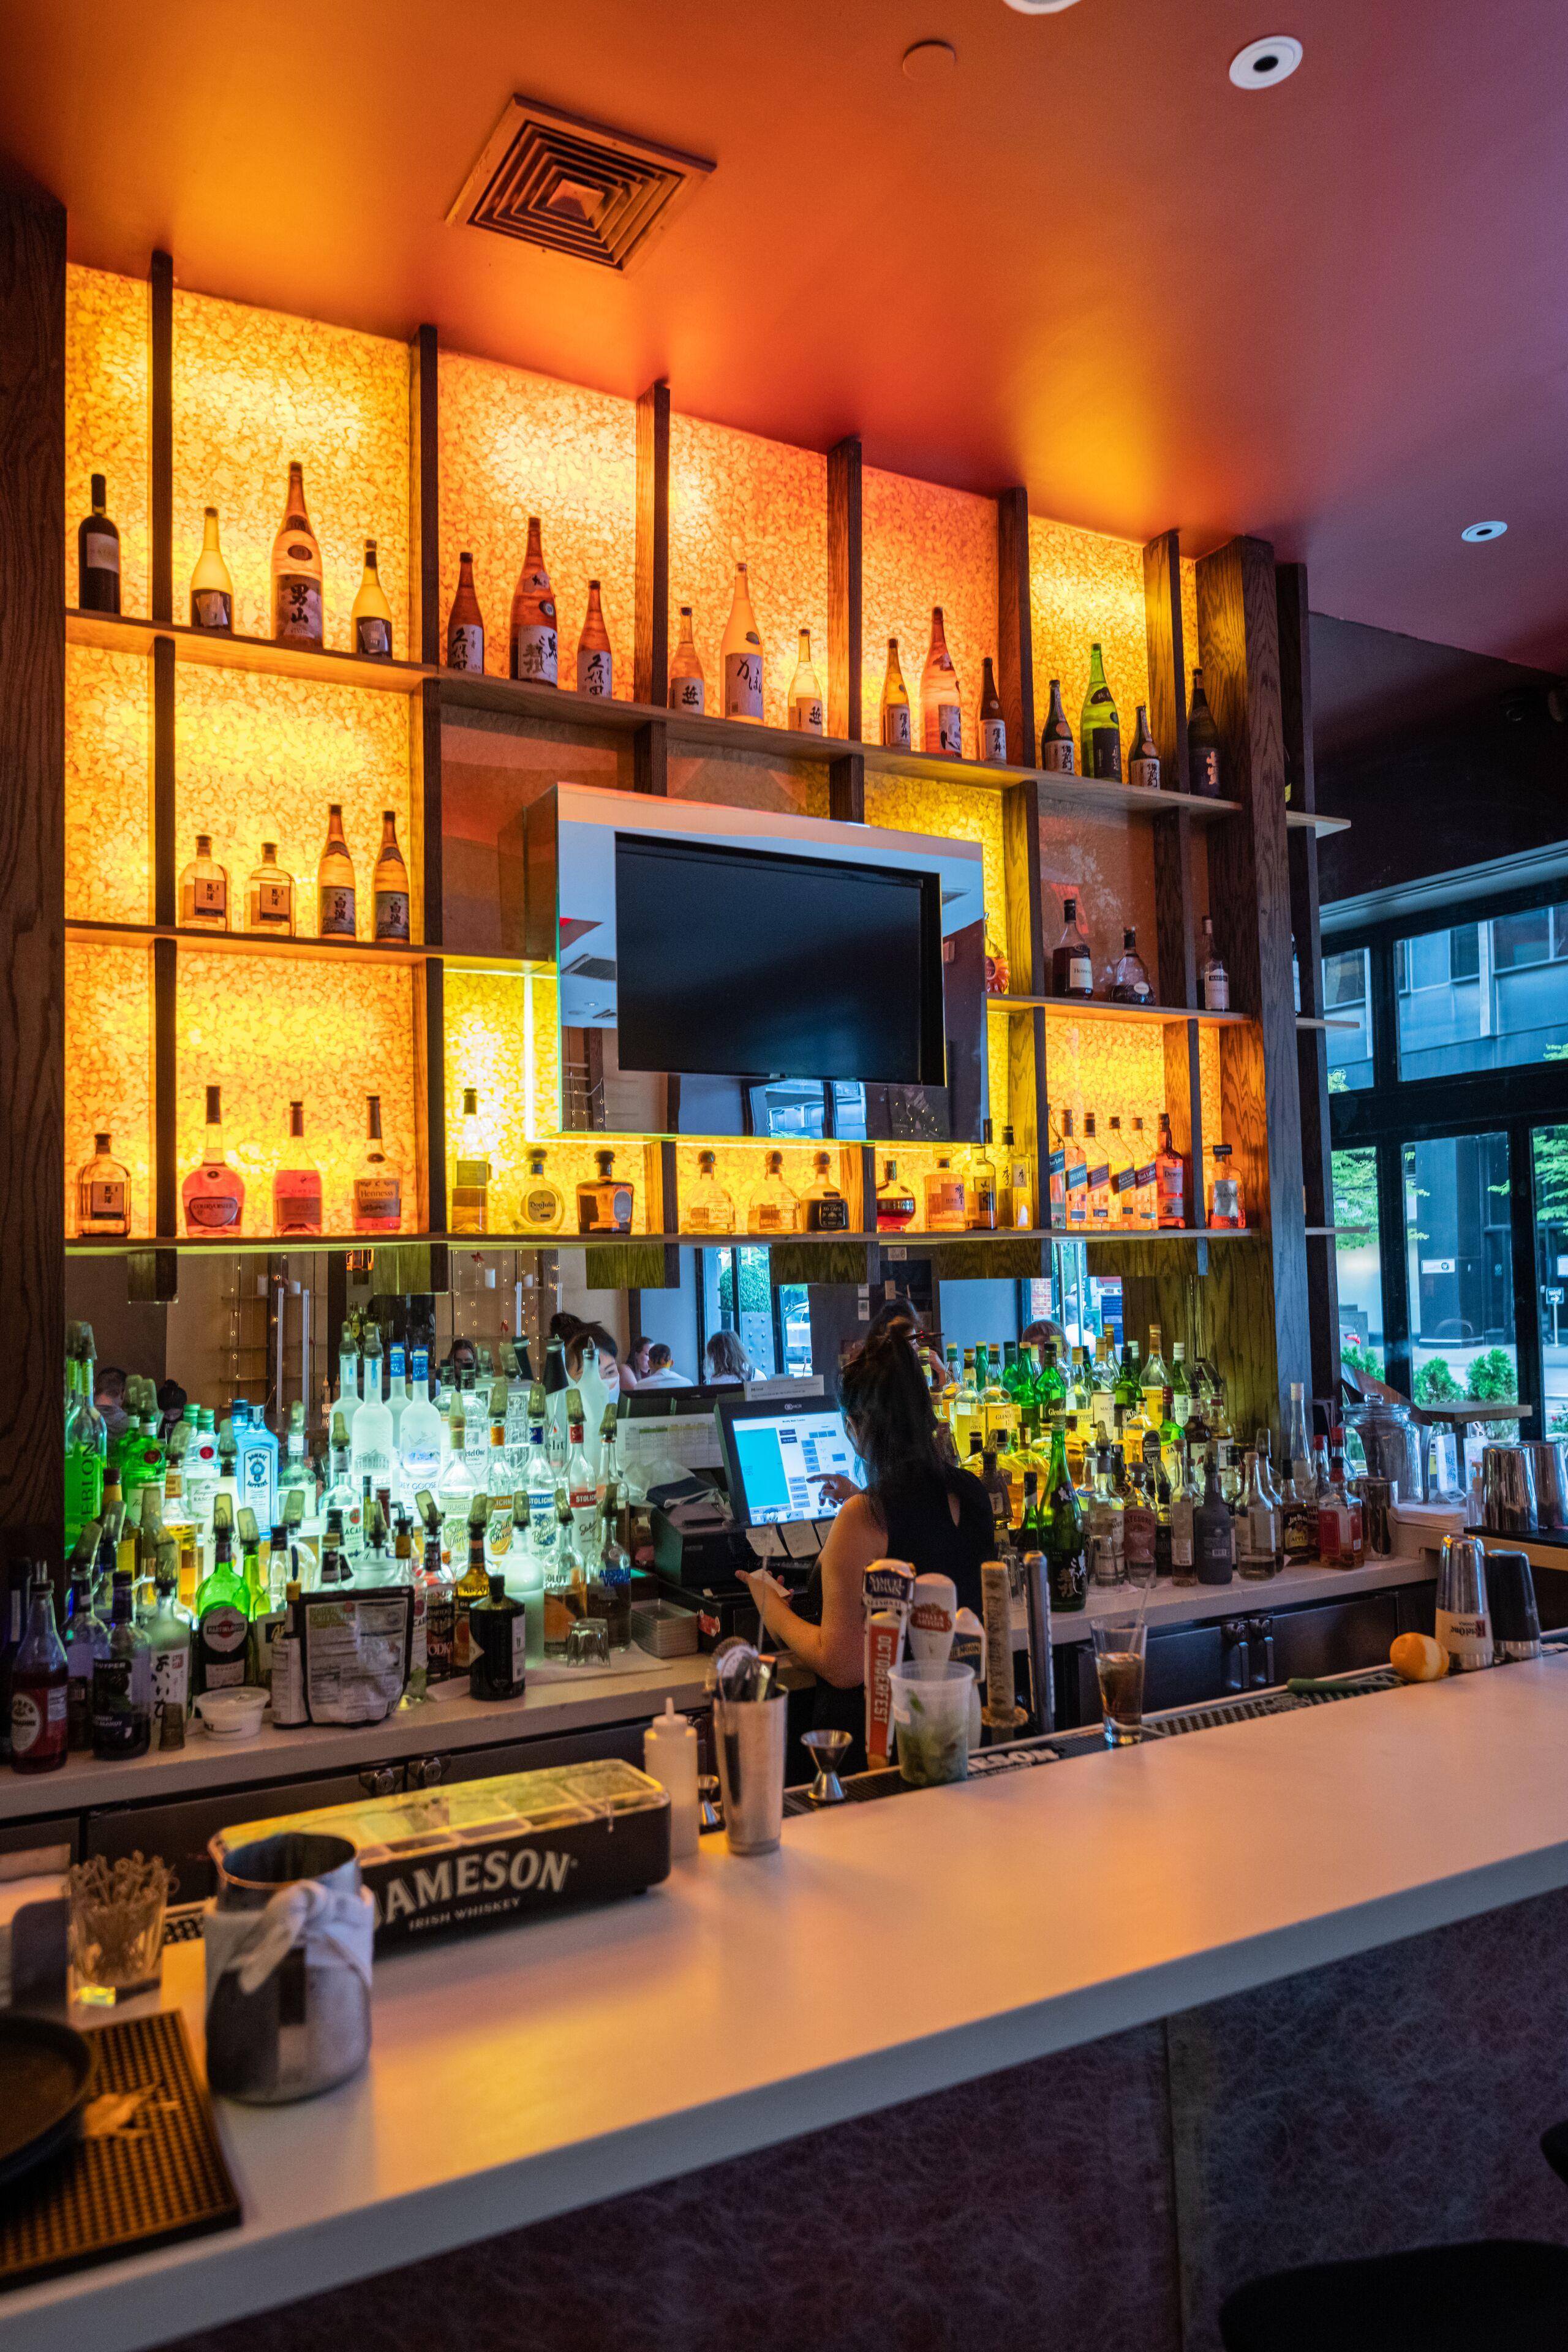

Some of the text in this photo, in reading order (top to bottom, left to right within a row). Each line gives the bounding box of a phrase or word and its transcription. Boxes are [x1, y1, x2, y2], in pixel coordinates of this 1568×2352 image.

[545, 1440, 565, 1451] elit
[81, 1441, 94, 1528] EBLON
[412, 1481, 437, 1490] GOOSE
[869, 1574, 904, 1589] SAMUEL
[872, 1582, 902, 1596] ADAMS
[918, 1611, 944, 1621] STELLA
[873, 1635, 892, 1724] OCTOBERFEST
[409, 1897, 521, 1932] IRISH WHISKEY
